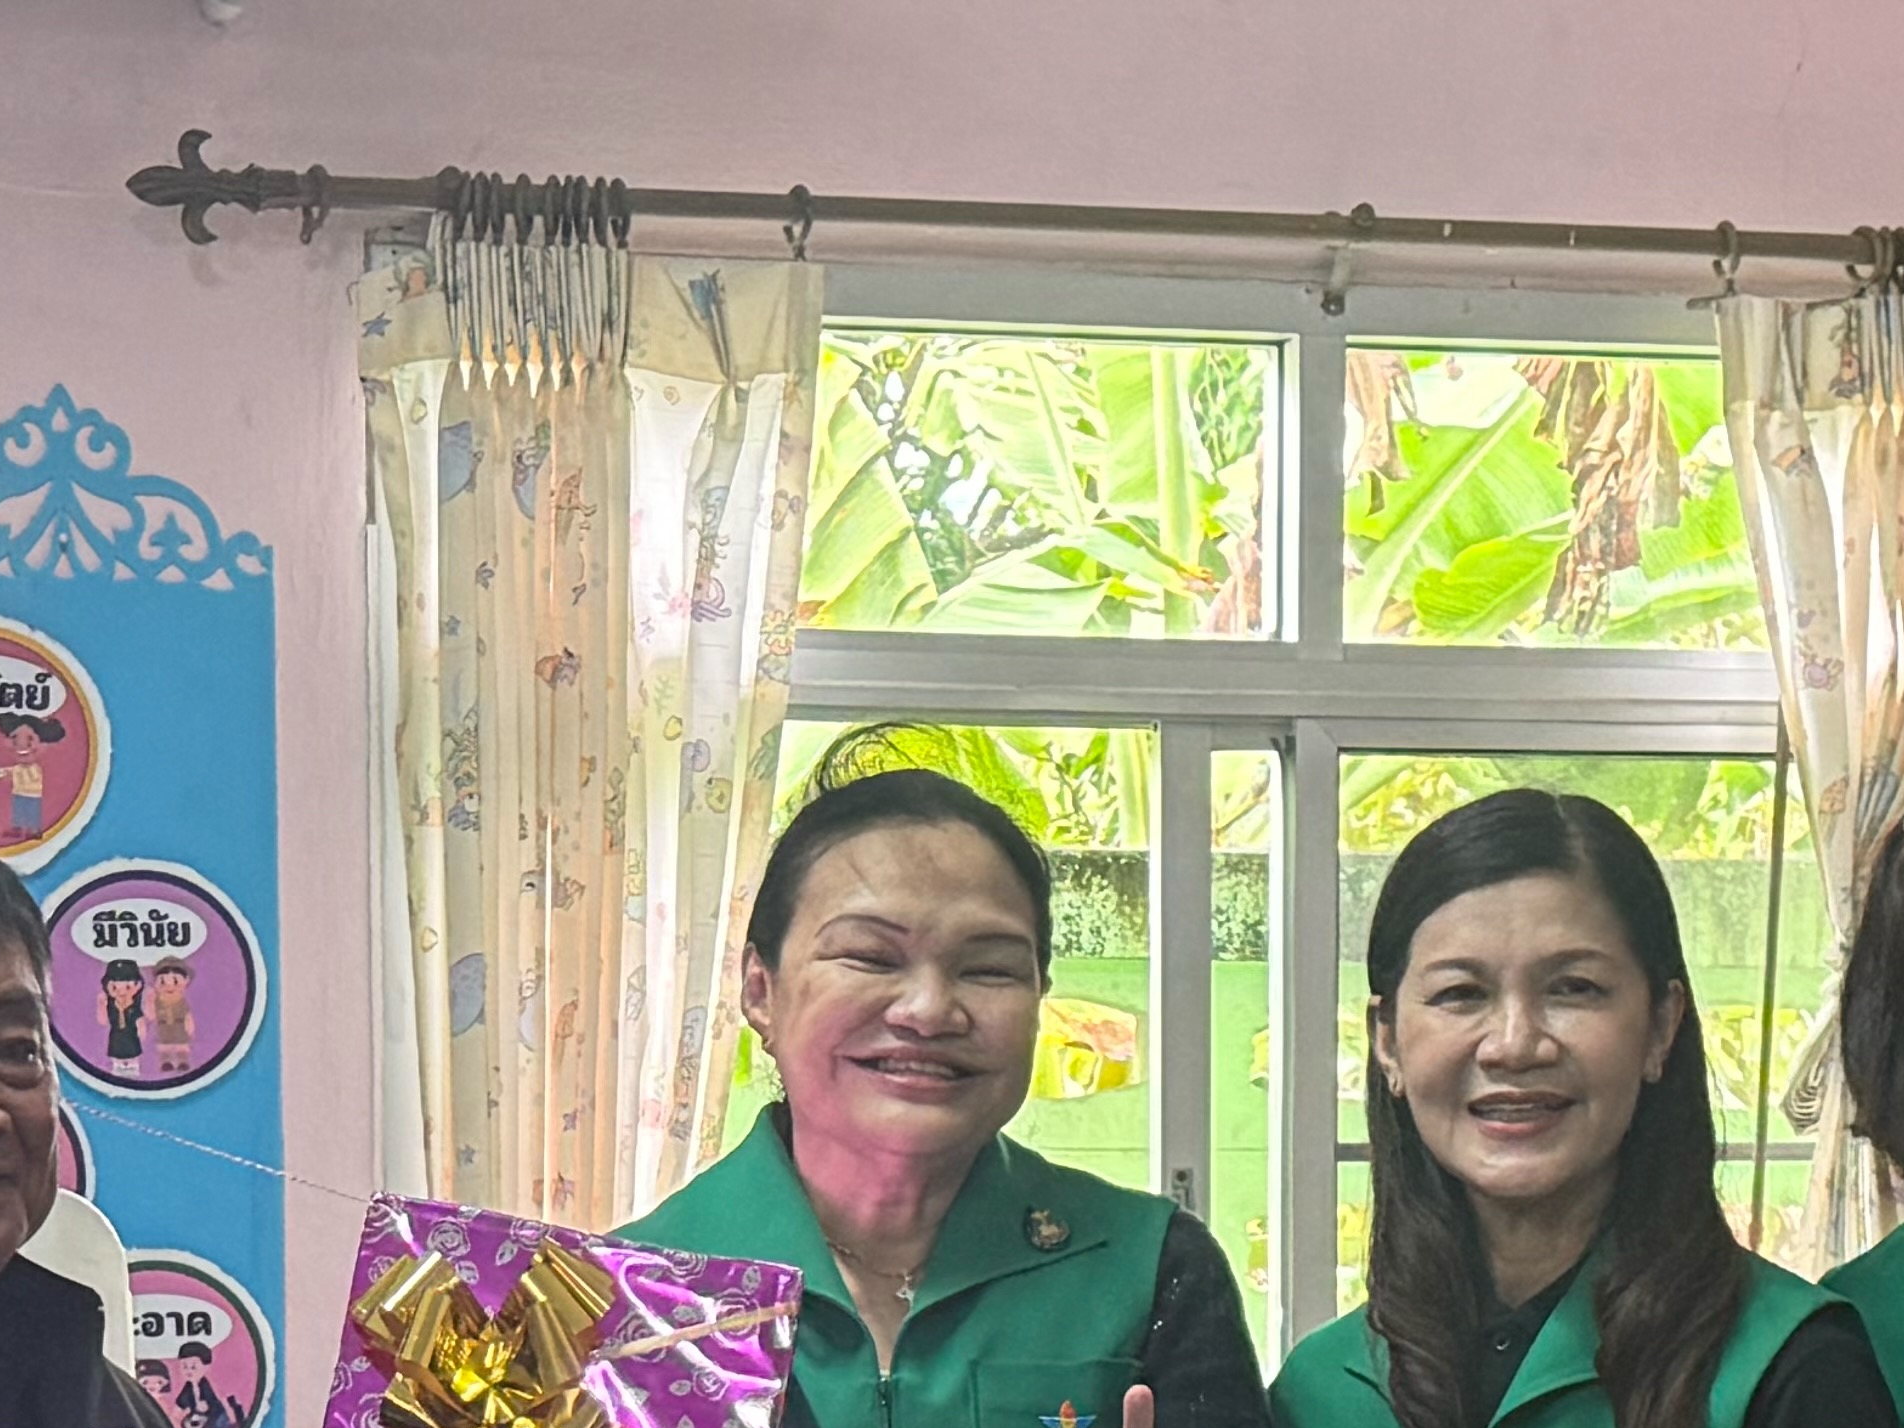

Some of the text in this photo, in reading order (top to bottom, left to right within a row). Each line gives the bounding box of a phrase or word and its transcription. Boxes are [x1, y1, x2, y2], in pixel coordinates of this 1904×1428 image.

[92, 909, 192, 949] มีวินัย
[132, 1311, 212, 1338] ะอาด
